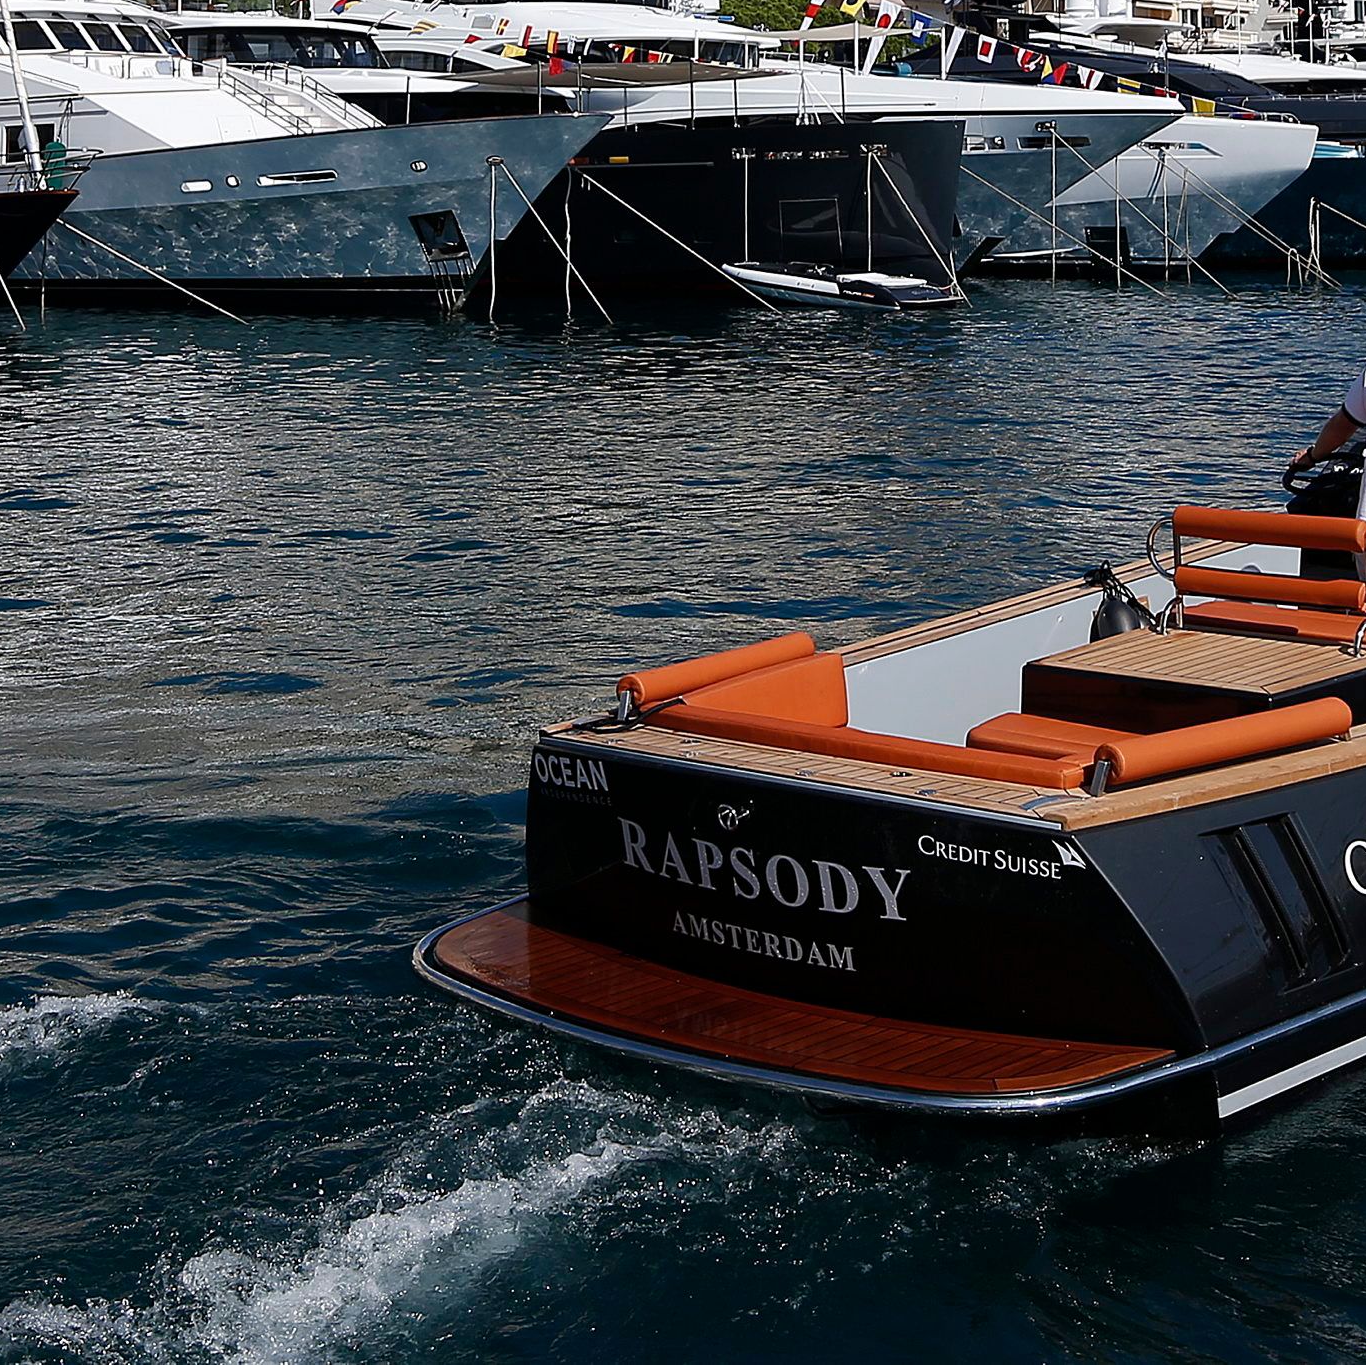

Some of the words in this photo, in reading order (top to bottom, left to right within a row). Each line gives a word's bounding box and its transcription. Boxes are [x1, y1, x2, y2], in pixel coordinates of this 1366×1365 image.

[535, 752, 609, 791] OCEAN
[617, 816, 912, 921] RAPSODY
[672, 909, 857, 972] AMSTERDAM
